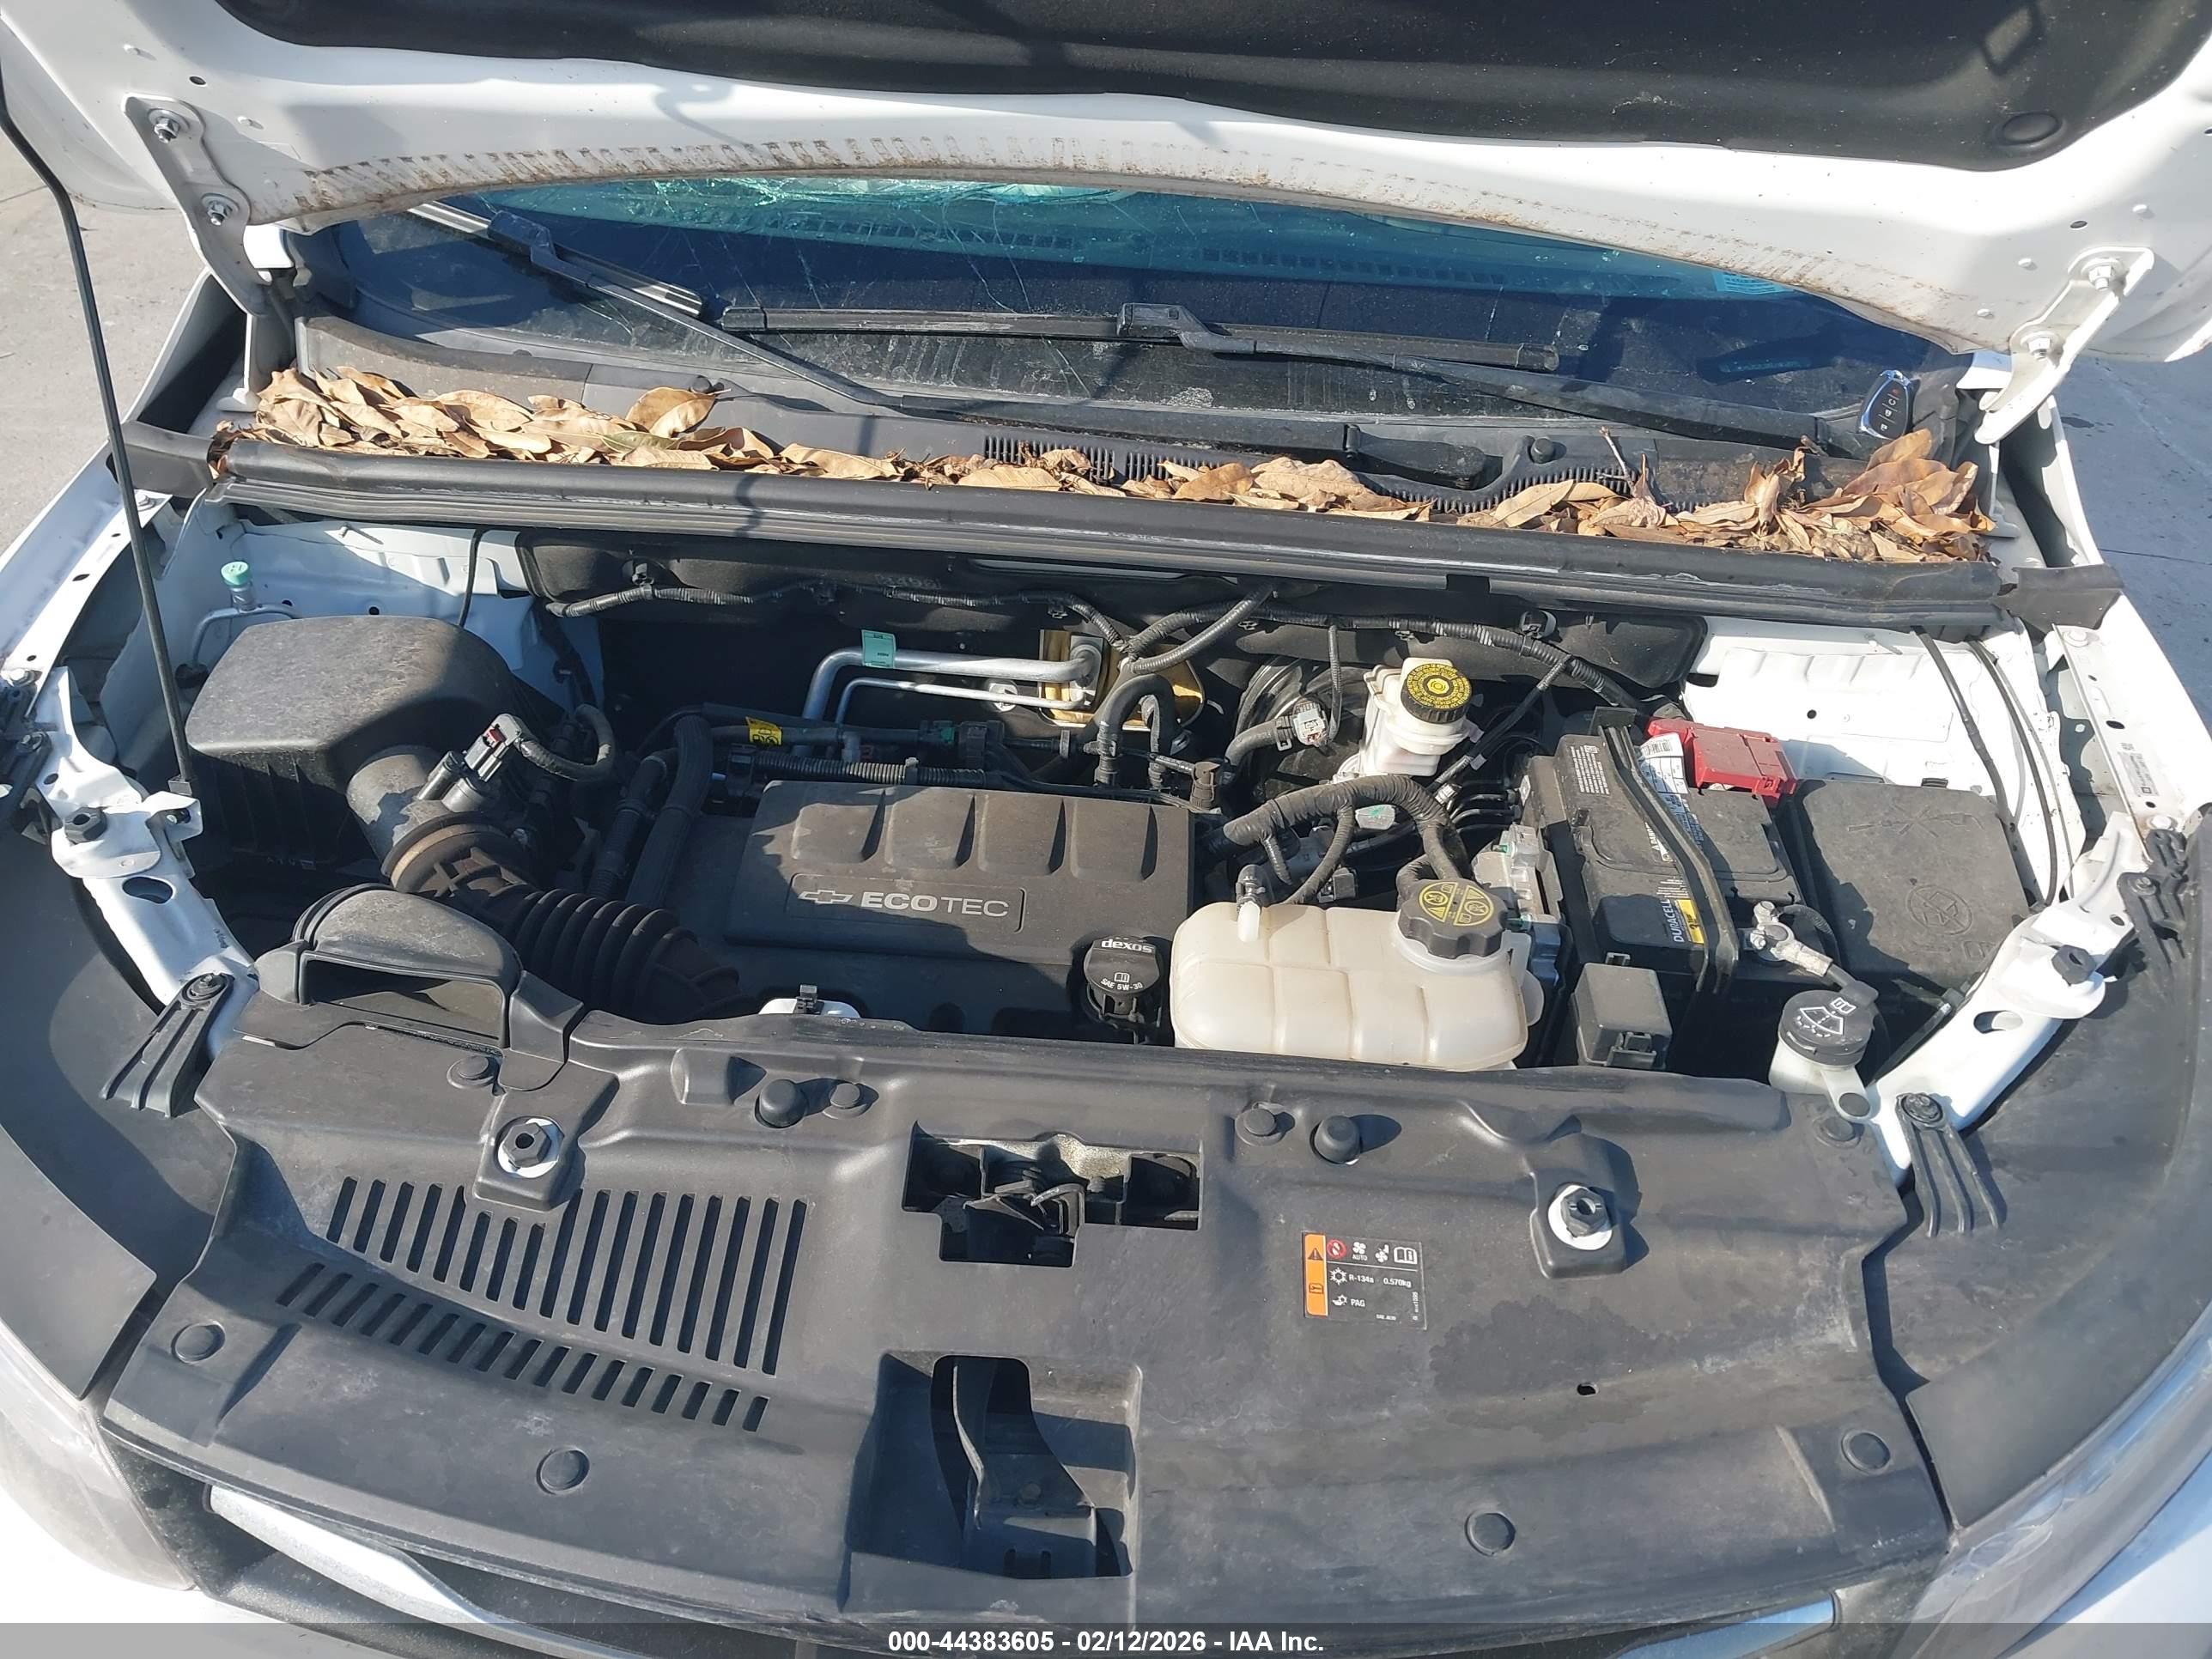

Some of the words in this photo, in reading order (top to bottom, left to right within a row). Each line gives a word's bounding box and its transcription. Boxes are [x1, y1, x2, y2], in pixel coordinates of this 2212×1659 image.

[860, 891, 1010, 917] ECOTEC
[1661, 899, 1685, 943] DURACELL
[1102, 939, 1152, 953] dexos
[1100, 978, 1115, 989] SAE
[1117, 981, 1144, 991] 5W-30
[1348, 1273, 1374, 1284] R-134a
[1351, 1298, 1365, 1308] PAG
